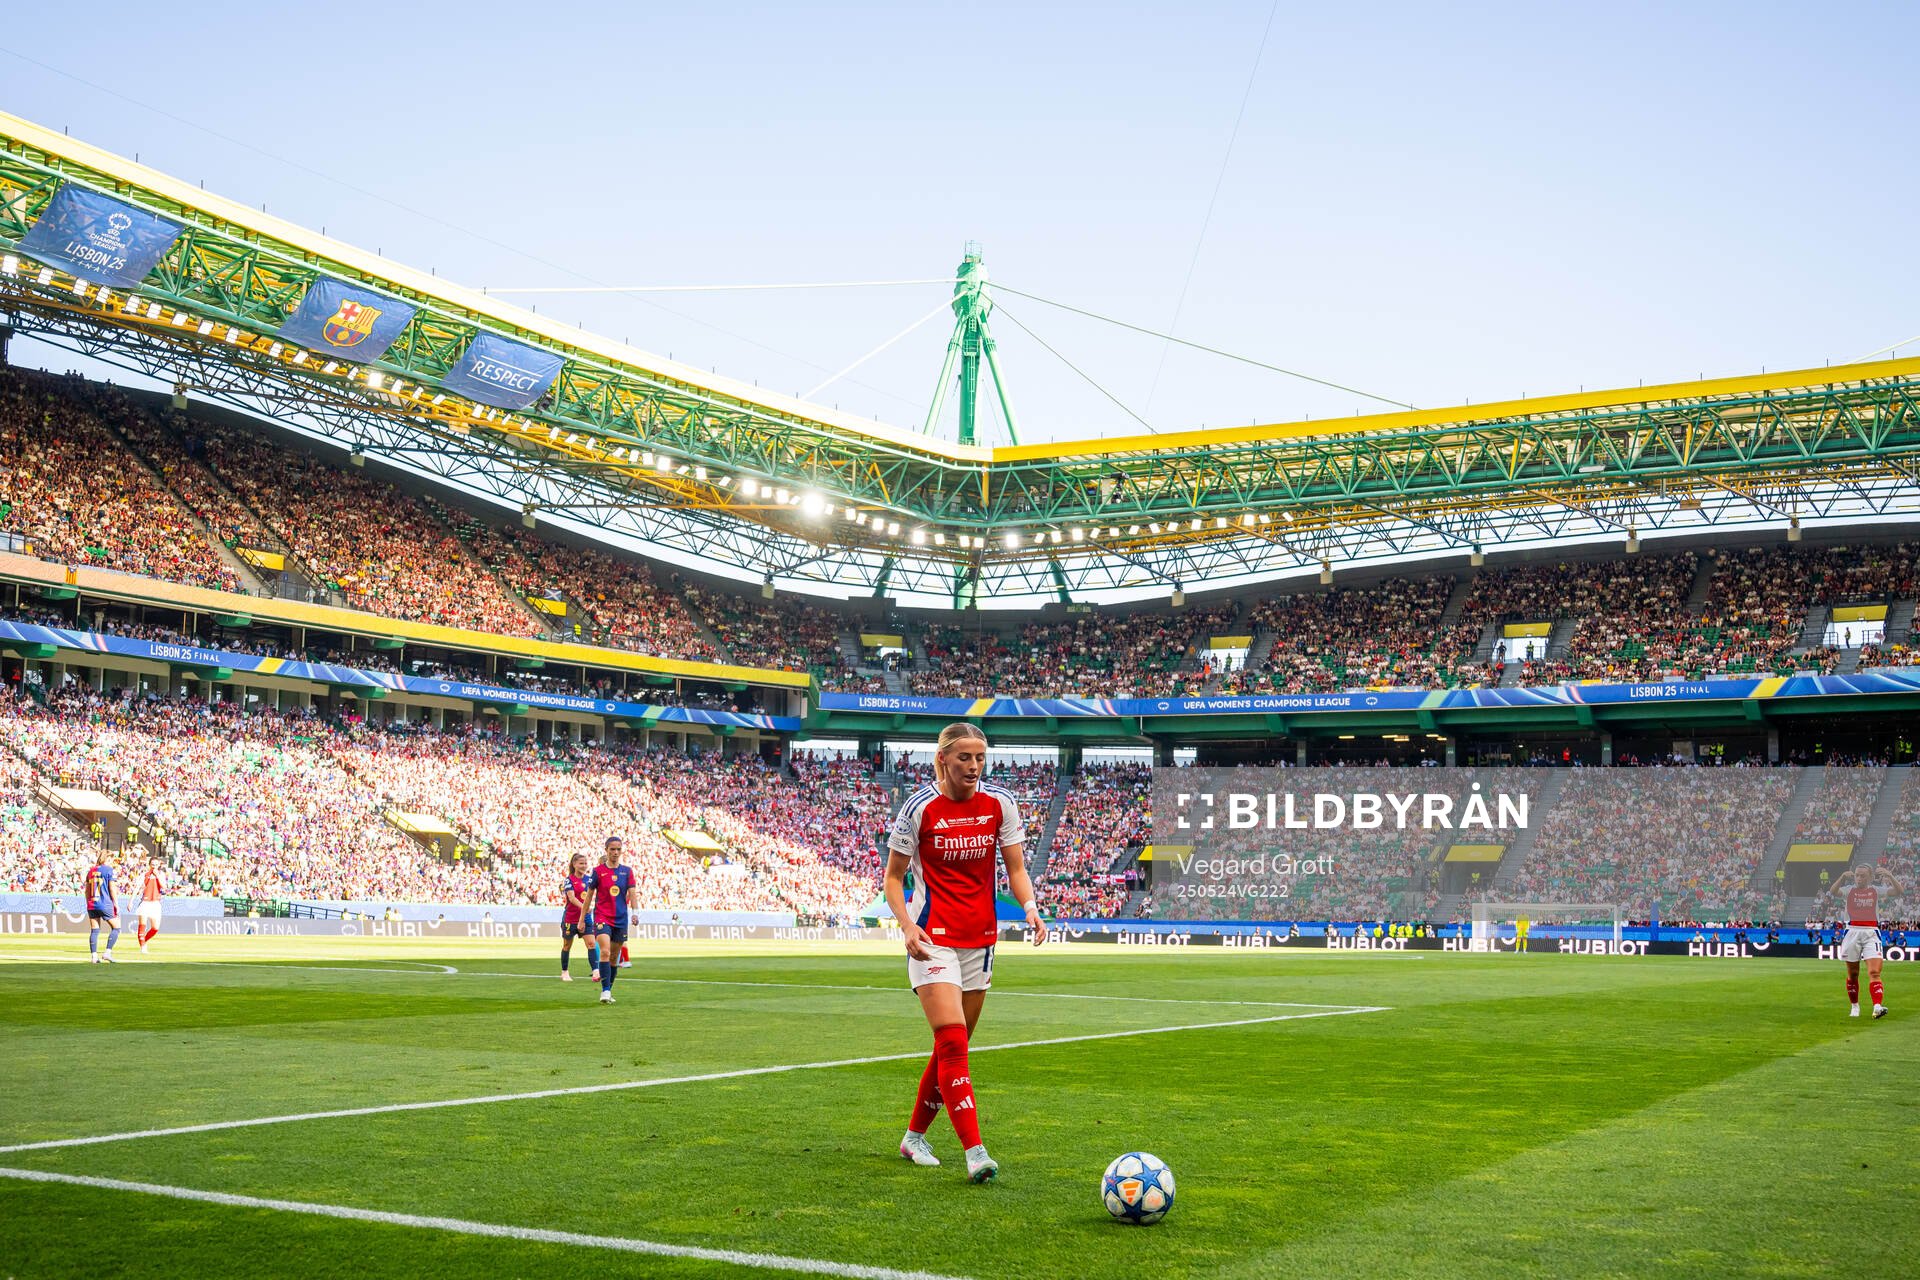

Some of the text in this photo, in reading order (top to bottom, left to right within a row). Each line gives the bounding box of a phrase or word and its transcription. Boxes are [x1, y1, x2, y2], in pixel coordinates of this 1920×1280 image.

[64, 241, 127, 270] LISBON 25
[471, 360, 539, 391] RESPECT
[150, 644, 220, 662] LISBON 25 FINAL
[461, 686, 595, 710] UEFA WOMEN'S CHAMPIONS LEAGUE
[1630, 685, 1710, 697] LISBON 25 FINAL
[859, 697, 928, 709] LISBON 25 FINAL
[1183, 697, 1350, 710] UEFA WOMEN'S CHAMPIONS LEAGUE
[934, 833, 995, 849] Emirates
[943, 848, 987, 861] FLY BETTER
[636, 924, 695, 939] HUBLOT
[1117, 933, 1191, 946] HUBLOT
[1326, 937, 1408, 950] HUBLOT
[1560, 938, 1649, 956] HUBLOT
